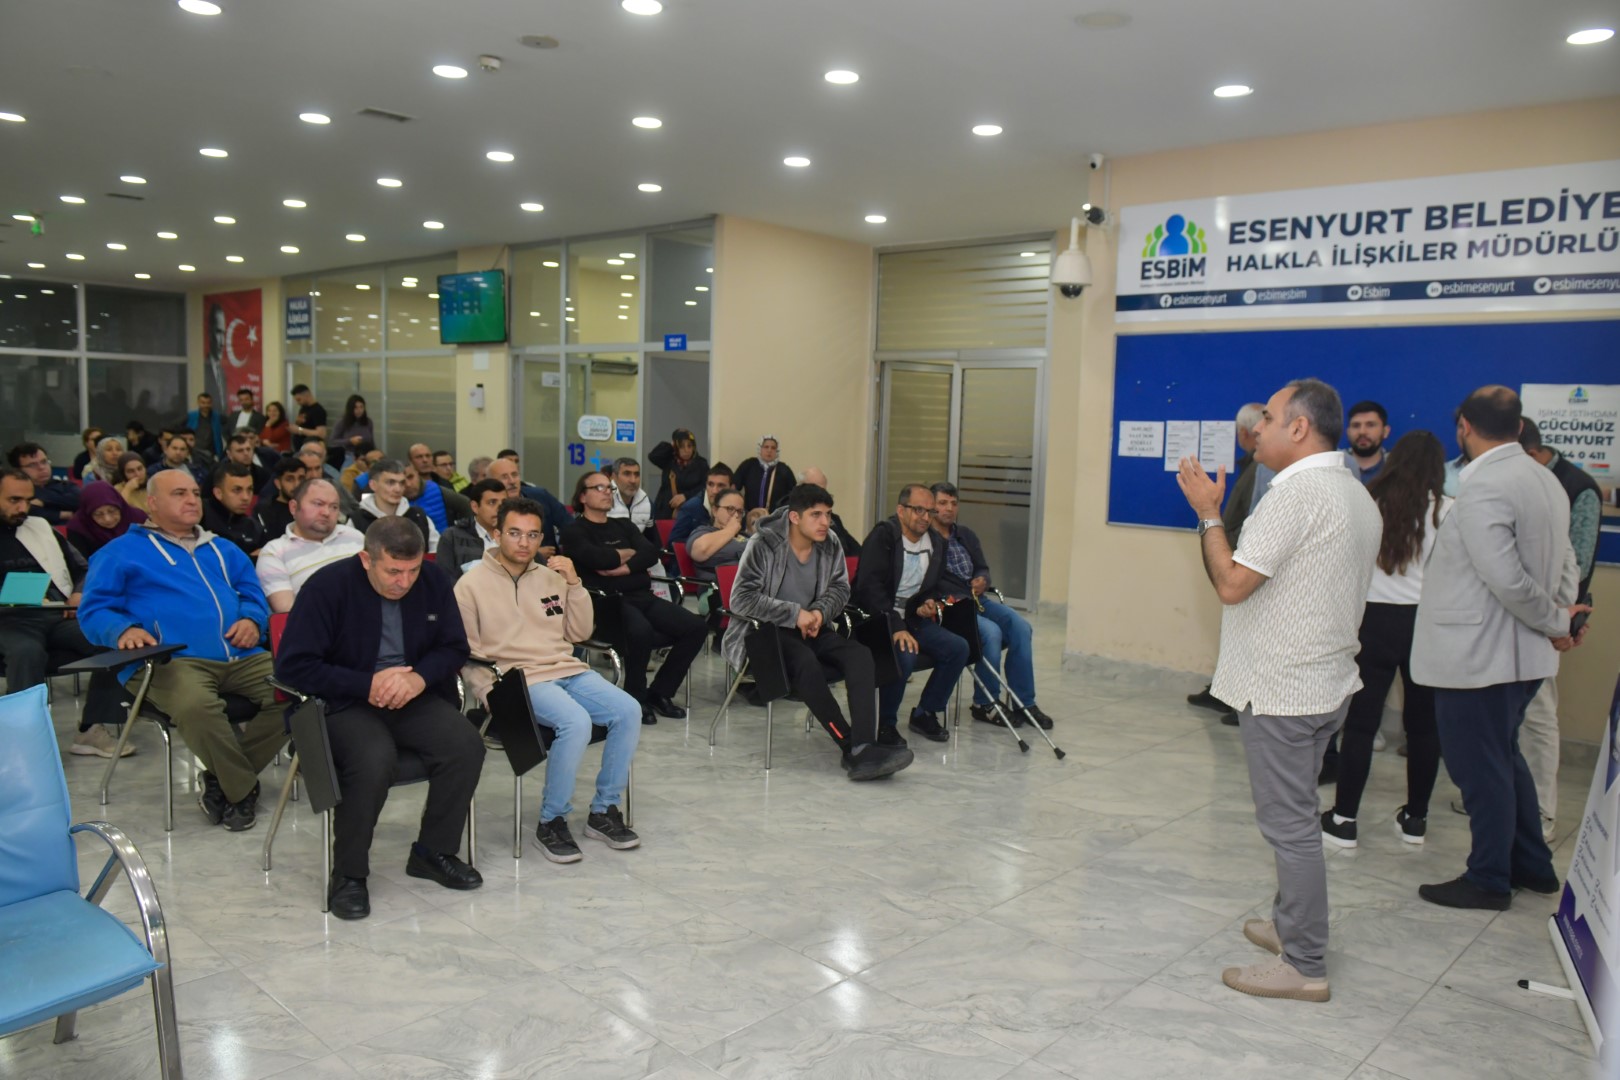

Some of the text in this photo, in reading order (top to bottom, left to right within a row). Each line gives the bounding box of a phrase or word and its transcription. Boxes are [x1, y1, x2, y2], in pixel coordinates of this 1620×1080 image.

[1228, 187, 1620, 245] ESENYURT BELEDİYE
[1226, 226, 1620, 272] HALKLA İLİŞKİLER MÜDÜRLÜ
[1362, 286, 1391, 299] Esbim
[1442, 280, 1516, 295] esbimesenyurt
[1172, 293, 1228, 306] esbimesenyurt
[1258, 289, 1307, 301] esbimesbim
[1538, 418, 1615, 432] GÜCÜMÜZ
[567, 443, 585, 465] 13
[1578, 451, 1585, 459] 0
[1589, 451, 1606, 460] 411
